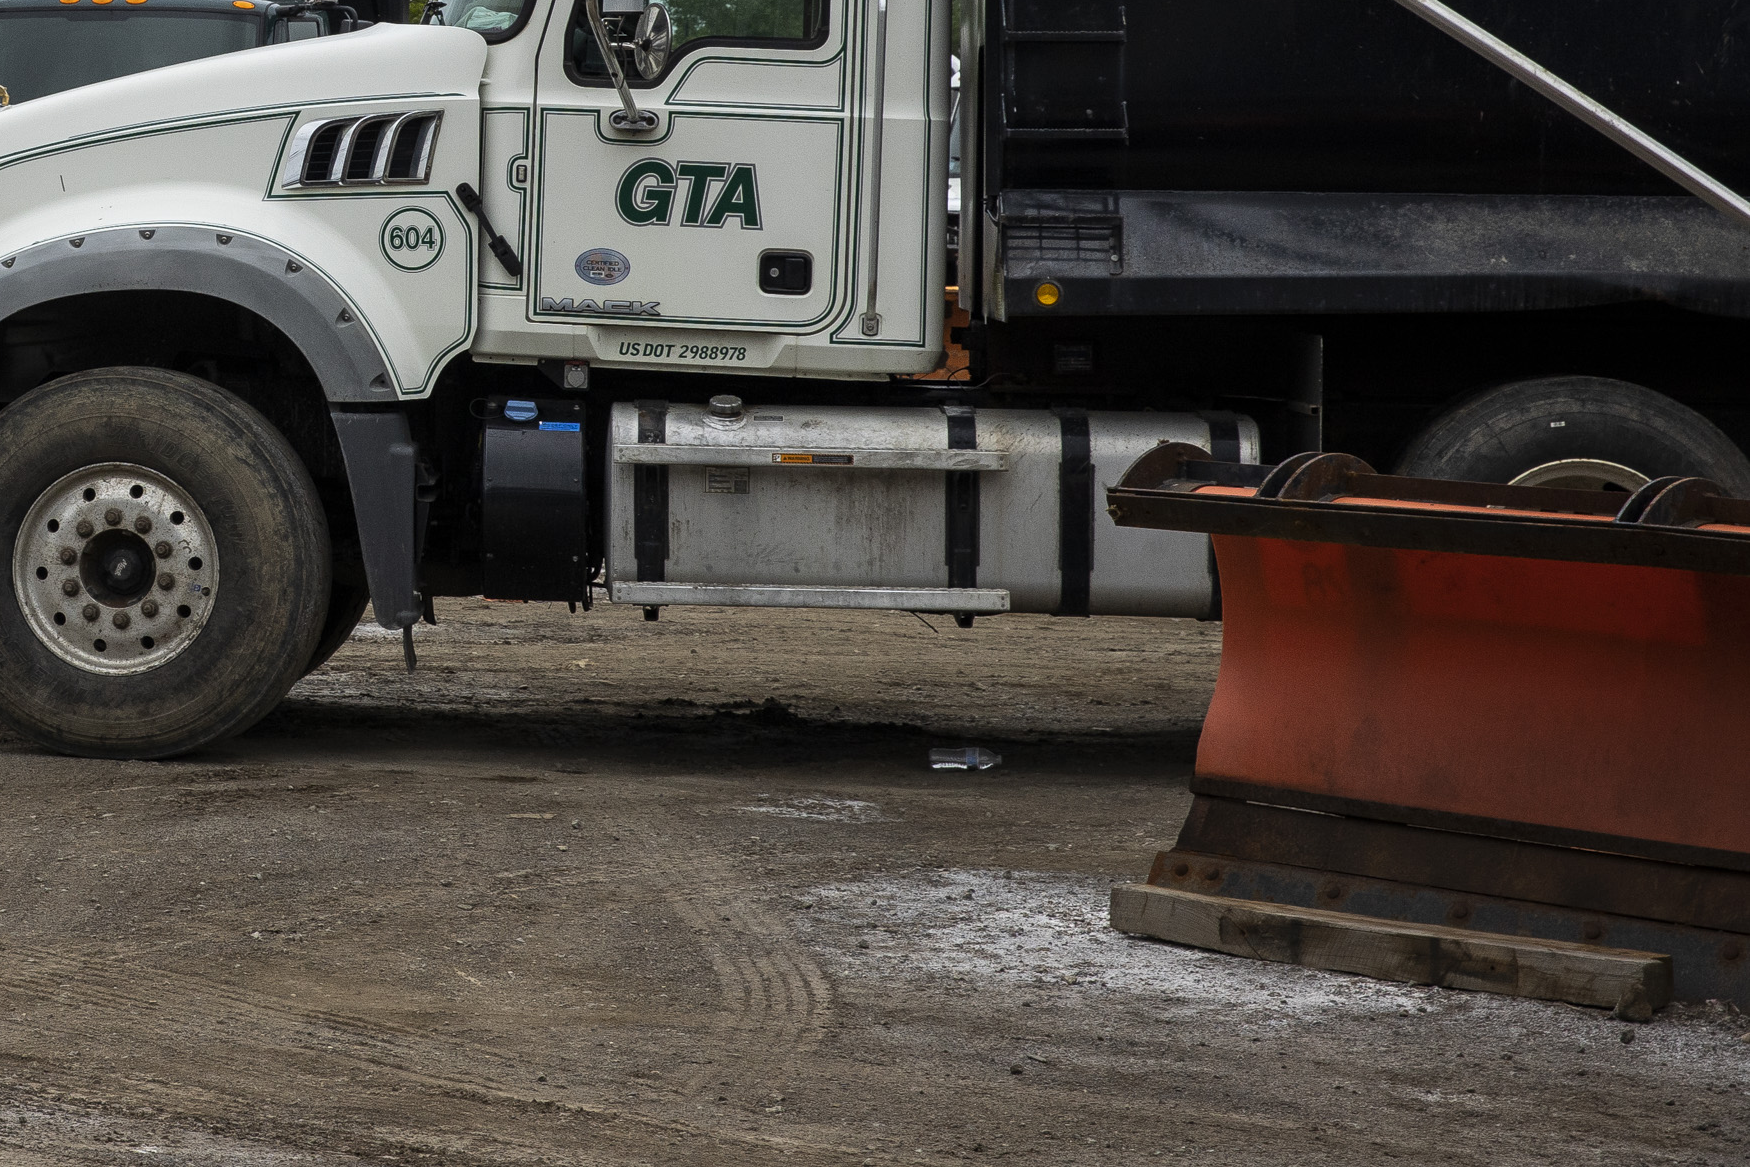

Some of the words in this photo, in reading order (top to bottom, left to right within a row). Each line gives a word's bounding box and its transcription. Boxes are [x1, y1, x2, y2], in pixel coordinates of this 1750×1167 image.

[615, 157, 763, 231] GTA
[388, 225, 437, 251] 604
[542, 297, 661, 316] MACK
[619, 341, 641, 357] US
[643, 343, 675, 358] DOT
[678, 344, 747, 362] 2988978
